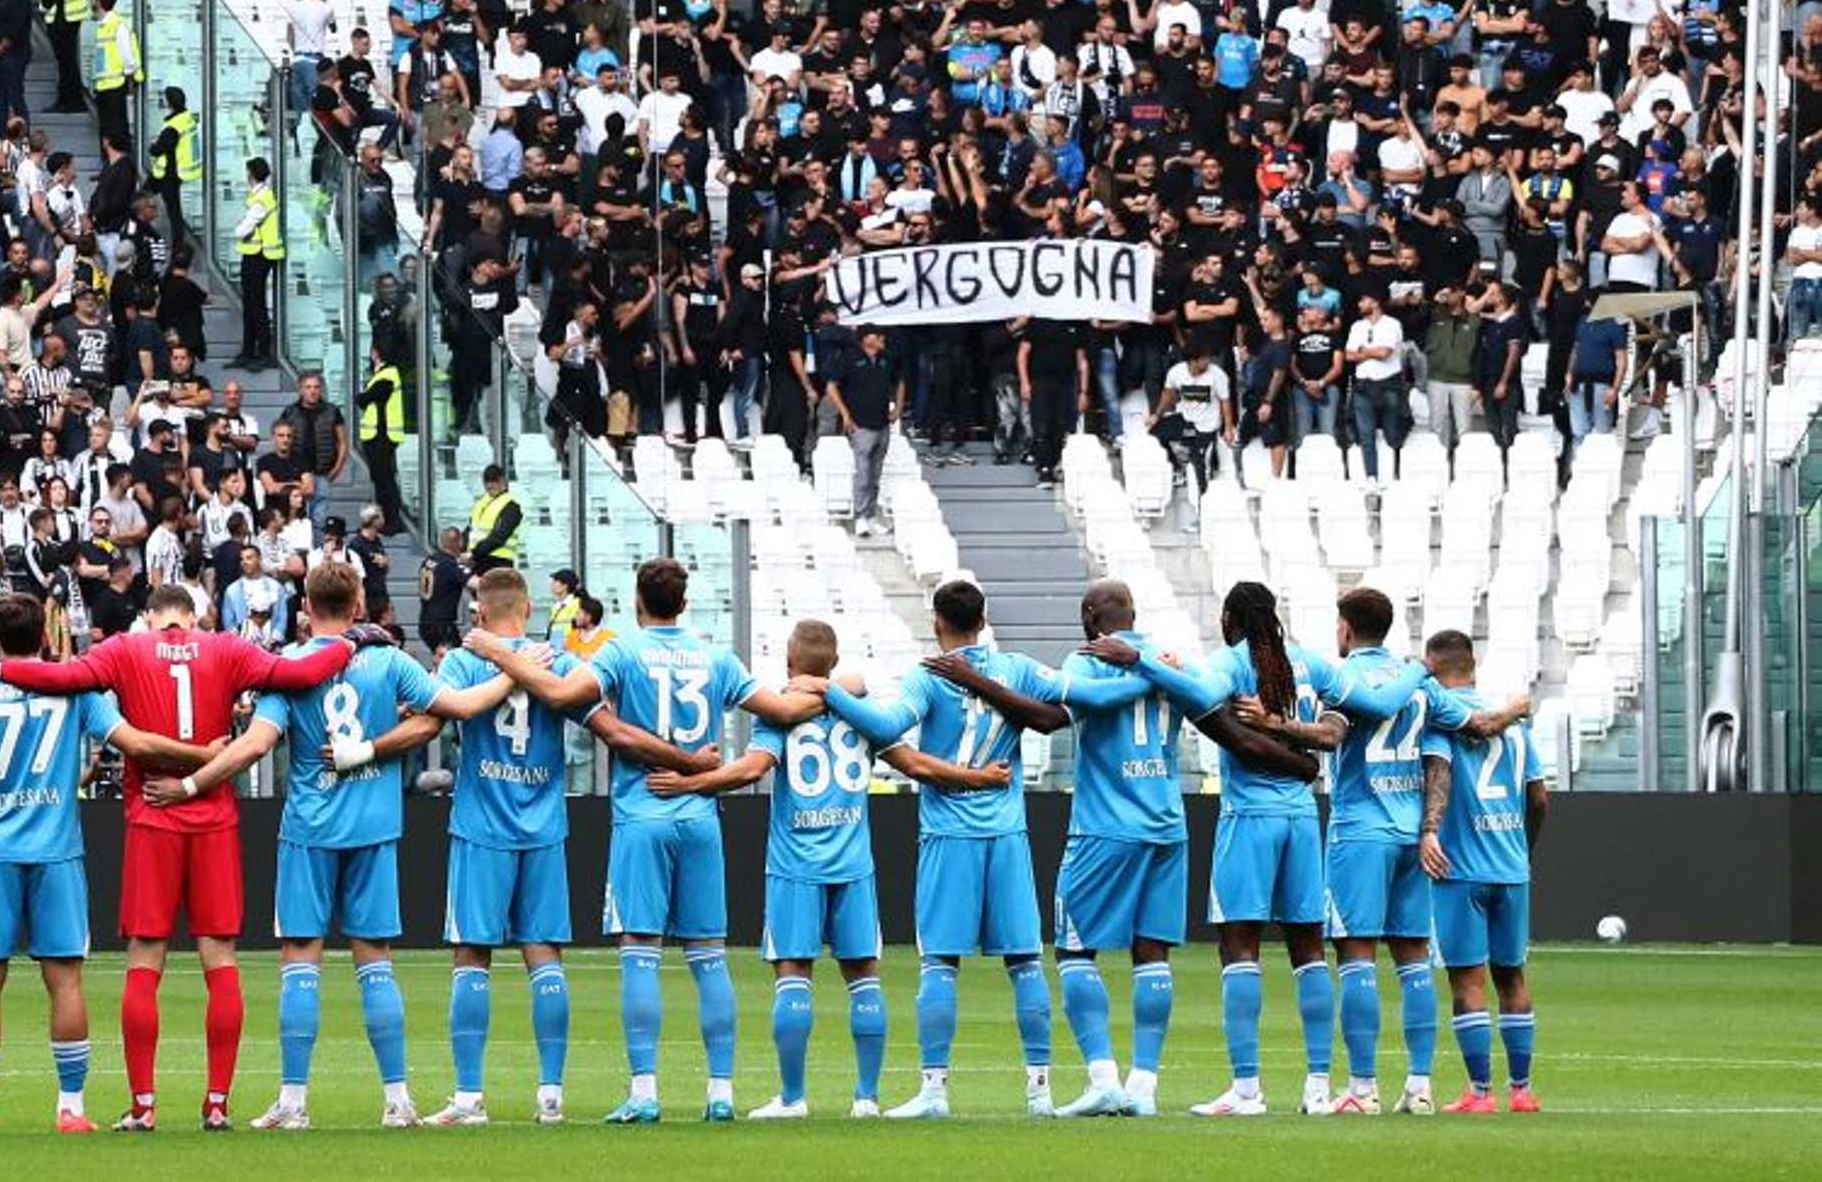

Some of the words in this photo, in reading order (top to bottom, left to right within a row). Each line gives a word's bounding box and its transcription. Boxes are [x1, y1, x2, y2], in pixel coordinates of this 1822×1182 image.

[832, 241, 1139, 316] VERGOGNA
[169, 664, 194, 740] 1
[323, 681, 365, 740] 8
[494, 689, 531, 756] 4
[647, 667, 710, 744] 13
[786, 720, 872, 797] 68
[1476, 724, 1526, 799] 21
